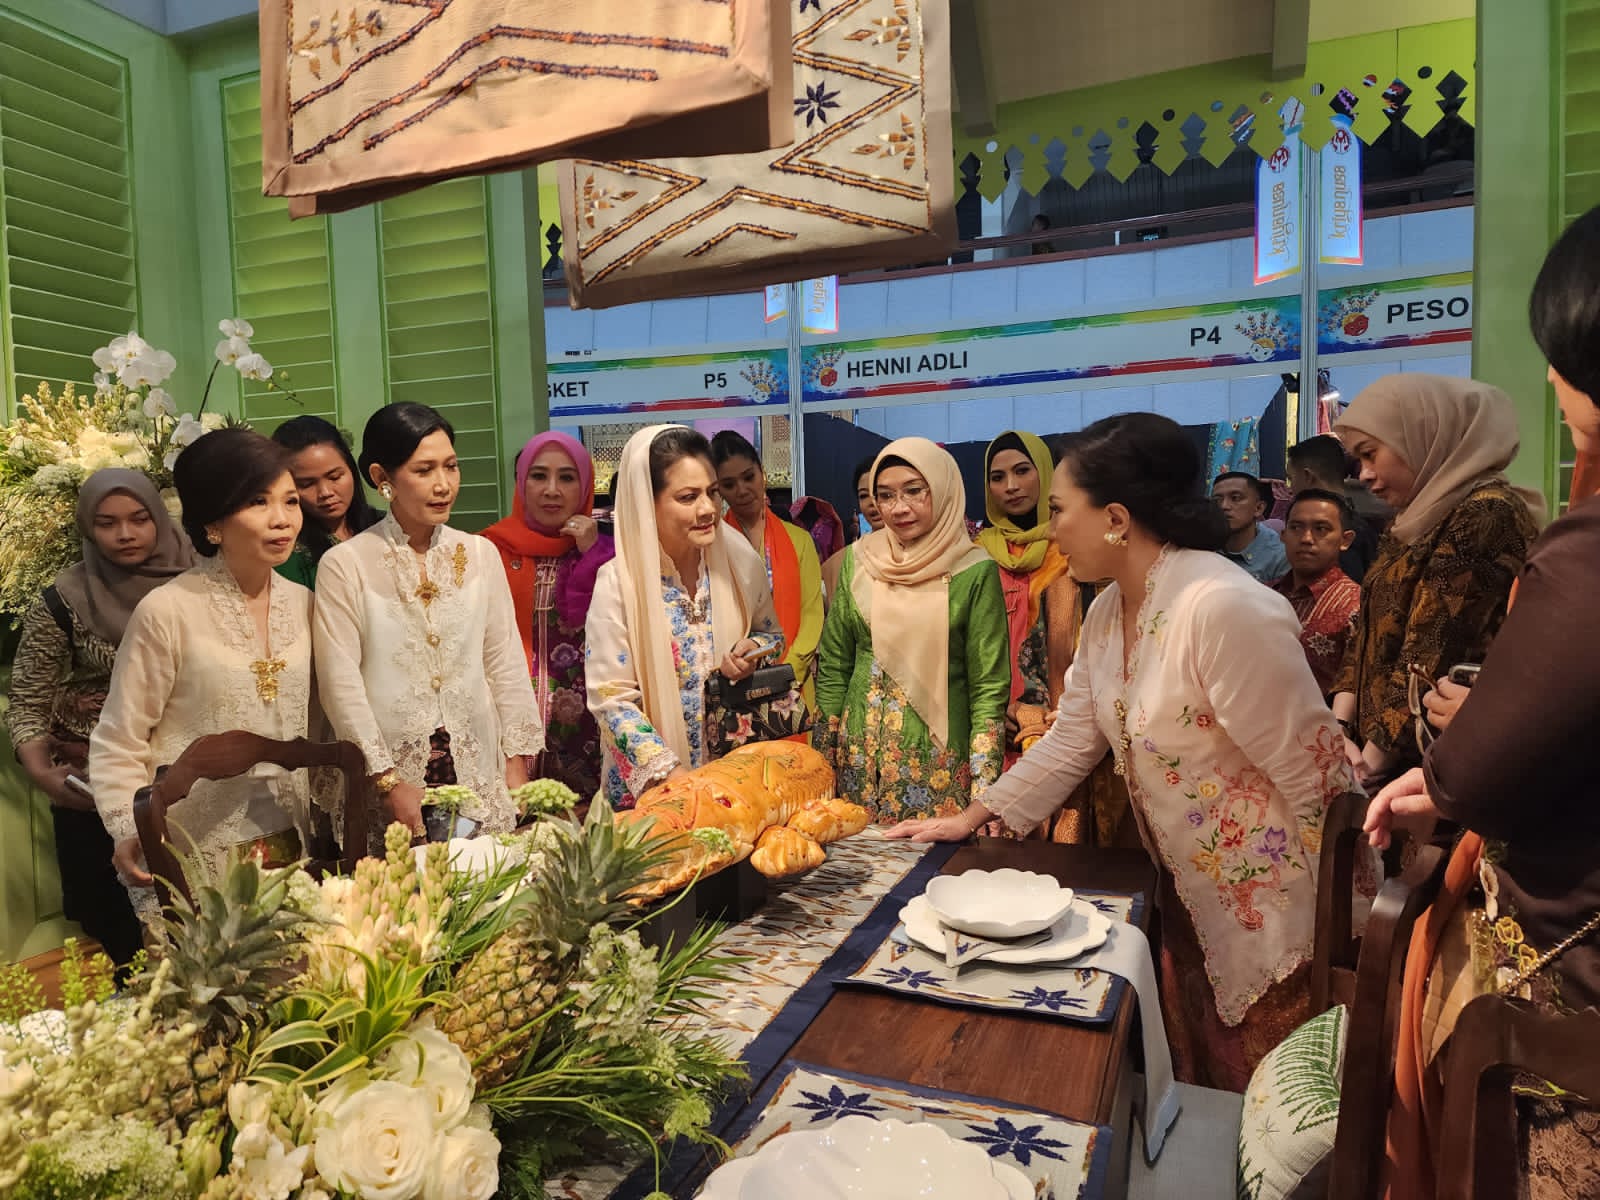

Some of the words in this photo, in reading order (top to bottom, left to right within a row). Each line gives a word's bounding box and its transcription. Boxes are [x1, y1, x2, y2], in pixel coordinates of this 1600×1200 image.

[808, 277, 827, 313] kriya
[1387, 297, 1470, 323] PESO
[1190, 326, 1222, 347] P4
[847, 356, 911, 378] HENNI
[917, 350, 968, 373] ADLI
[704, 372, 727, 389] P5
